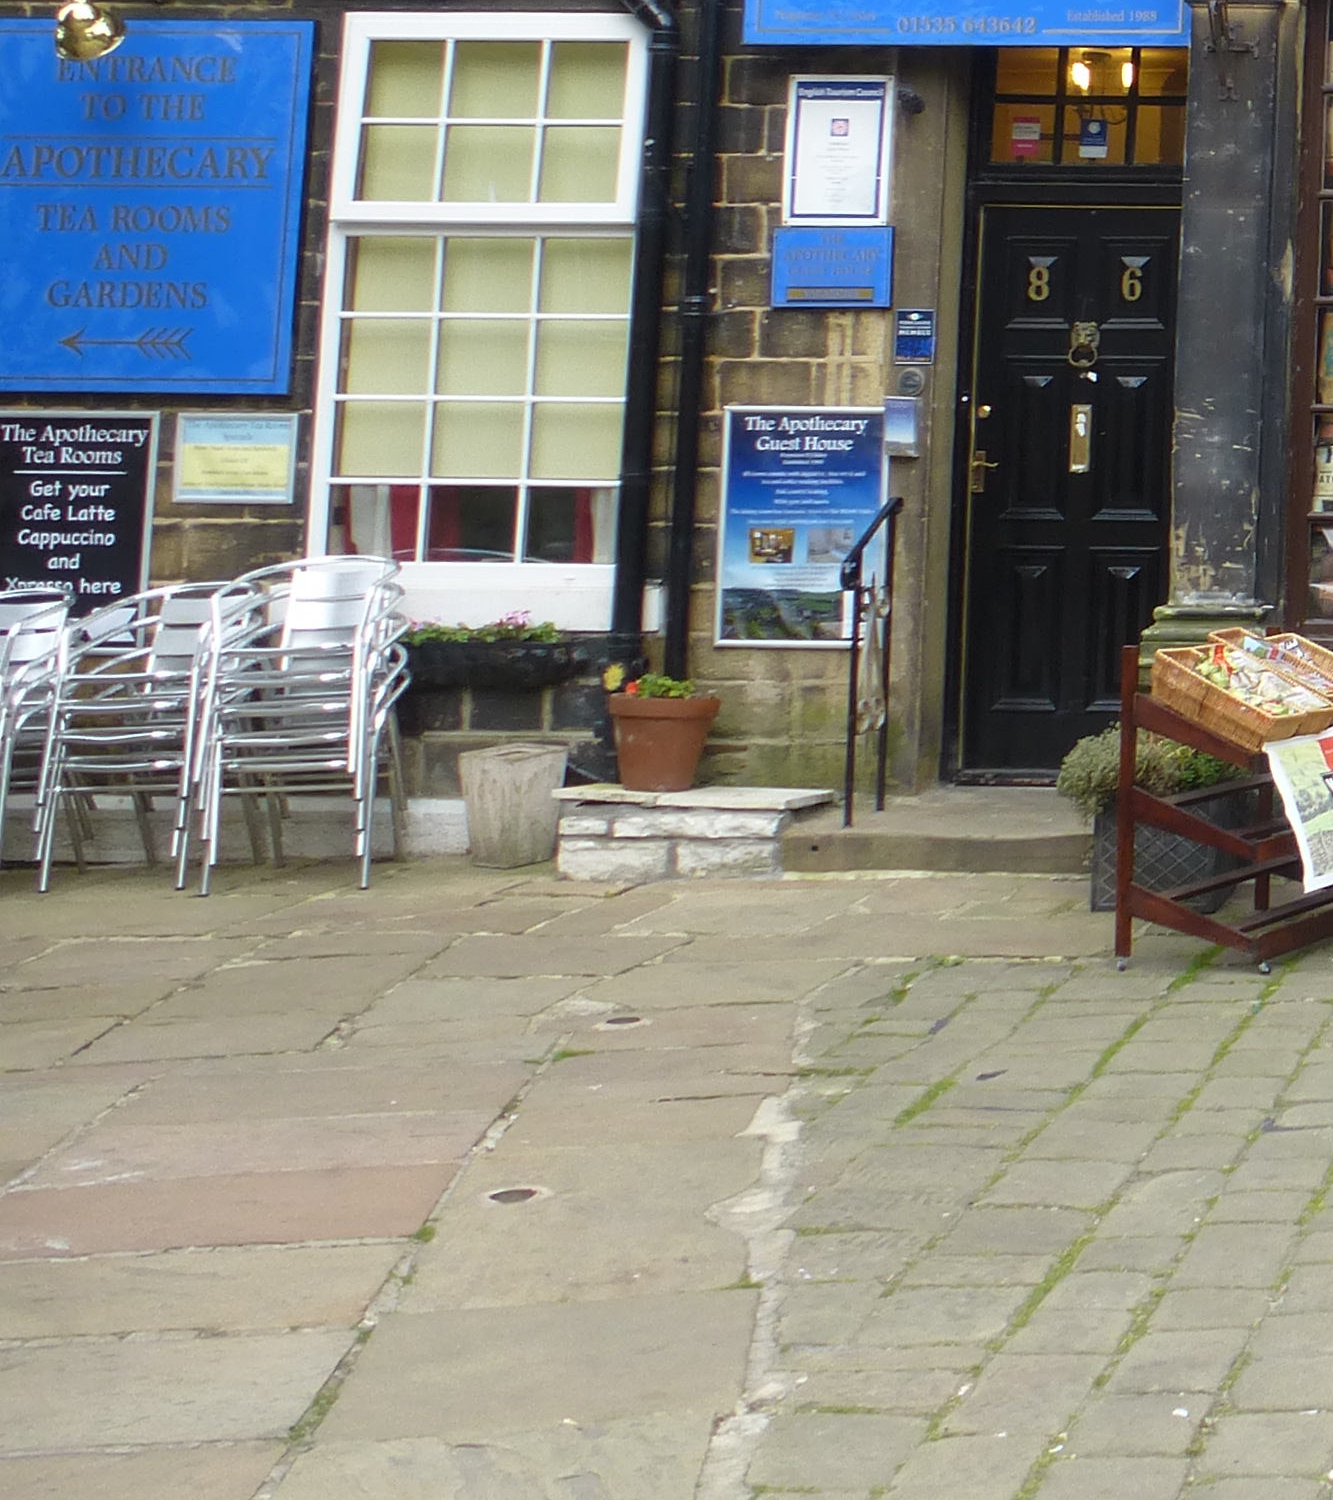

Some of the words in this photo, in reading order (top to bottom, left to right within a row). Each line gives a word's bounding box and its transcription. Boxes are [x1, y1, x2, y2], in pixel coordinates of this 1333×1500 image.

[898, 16, 955, 35] 01535
[963, 16, 1037, 35] 643642
[1067, 10, 1124, 22] Established
[1129, 10, 1157, 22] 1988
[57, 55, 237, 84] ENTRANCE
[82, 93, 130, 120] TO
[141, 94, 205, 121] THE
[2, 145, 277, 180] APOTHECARY
[37, 205, 99, 233] TEA
[110, 205, 232, 233] ROOMS
[93, 243, 168, 271] AND
[1028, 266, 1049, 301] 8
[1122, 266, 1142, 301] 6
[48, 281, 208, 310] GARDENS
[1, 424, 36, 442] The
[40, 424, 149, 447] Apothecary
[745, 416, 775, 431] The
[779, 416, 869, 435] Apothecary
[756, 436, 801, 451] Guest
[805, 436, 854, 451] House
[22, 447, 55, 464] Tea
[60, 447, 122, 464] Rooms
[29, 480, 61, 497] Get
[68, 483, 110, 500] your
[21, 505, 61, 521] Cafe
[67, 505, 115, 521] Latte
[18, 529, 116, 550] Cappuccino
[47, 553, 80, 570] and
[80, 578, 121, 594] here
